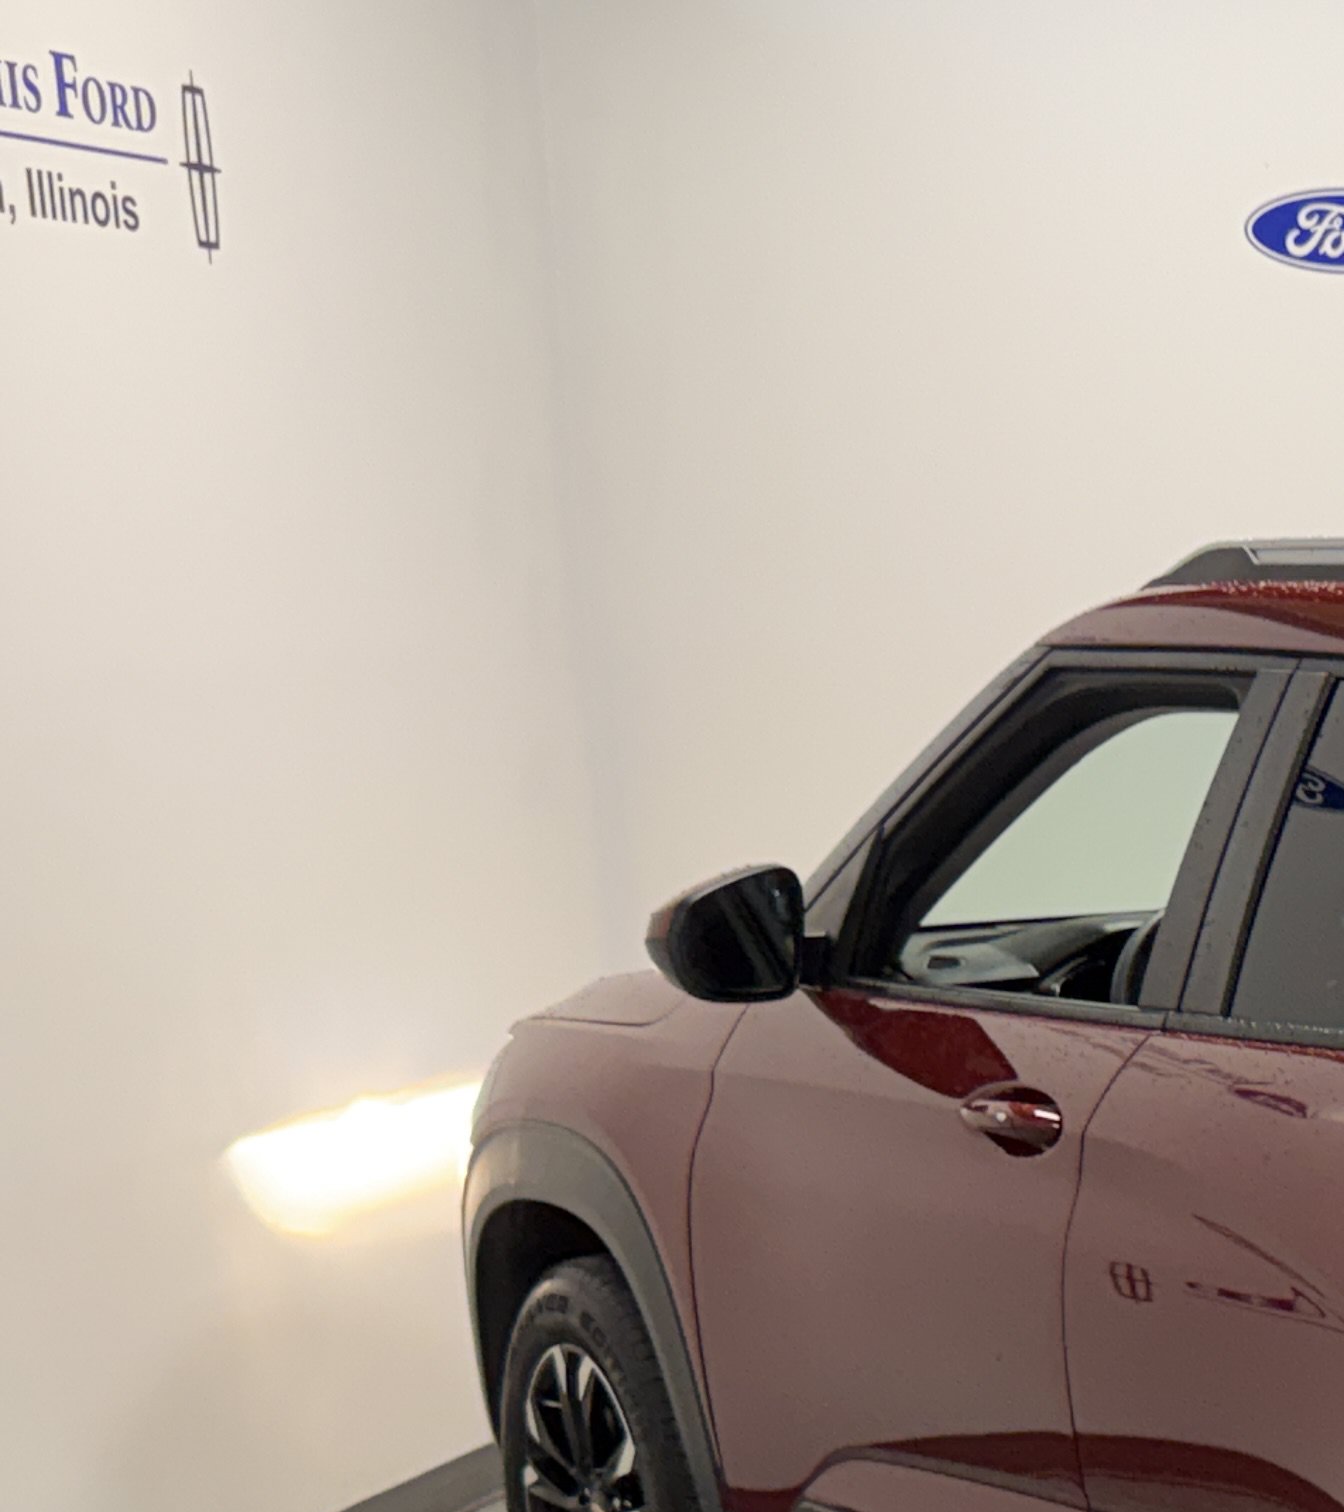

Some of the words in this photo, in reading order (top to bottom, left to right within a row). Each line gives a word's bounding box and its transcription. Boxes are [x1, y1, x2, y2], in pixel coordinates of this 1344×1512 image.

[0, 60, 42, 114] IS
[49, 50, 157, 133] FORD
[25, 167, 140, 232] Illinois
